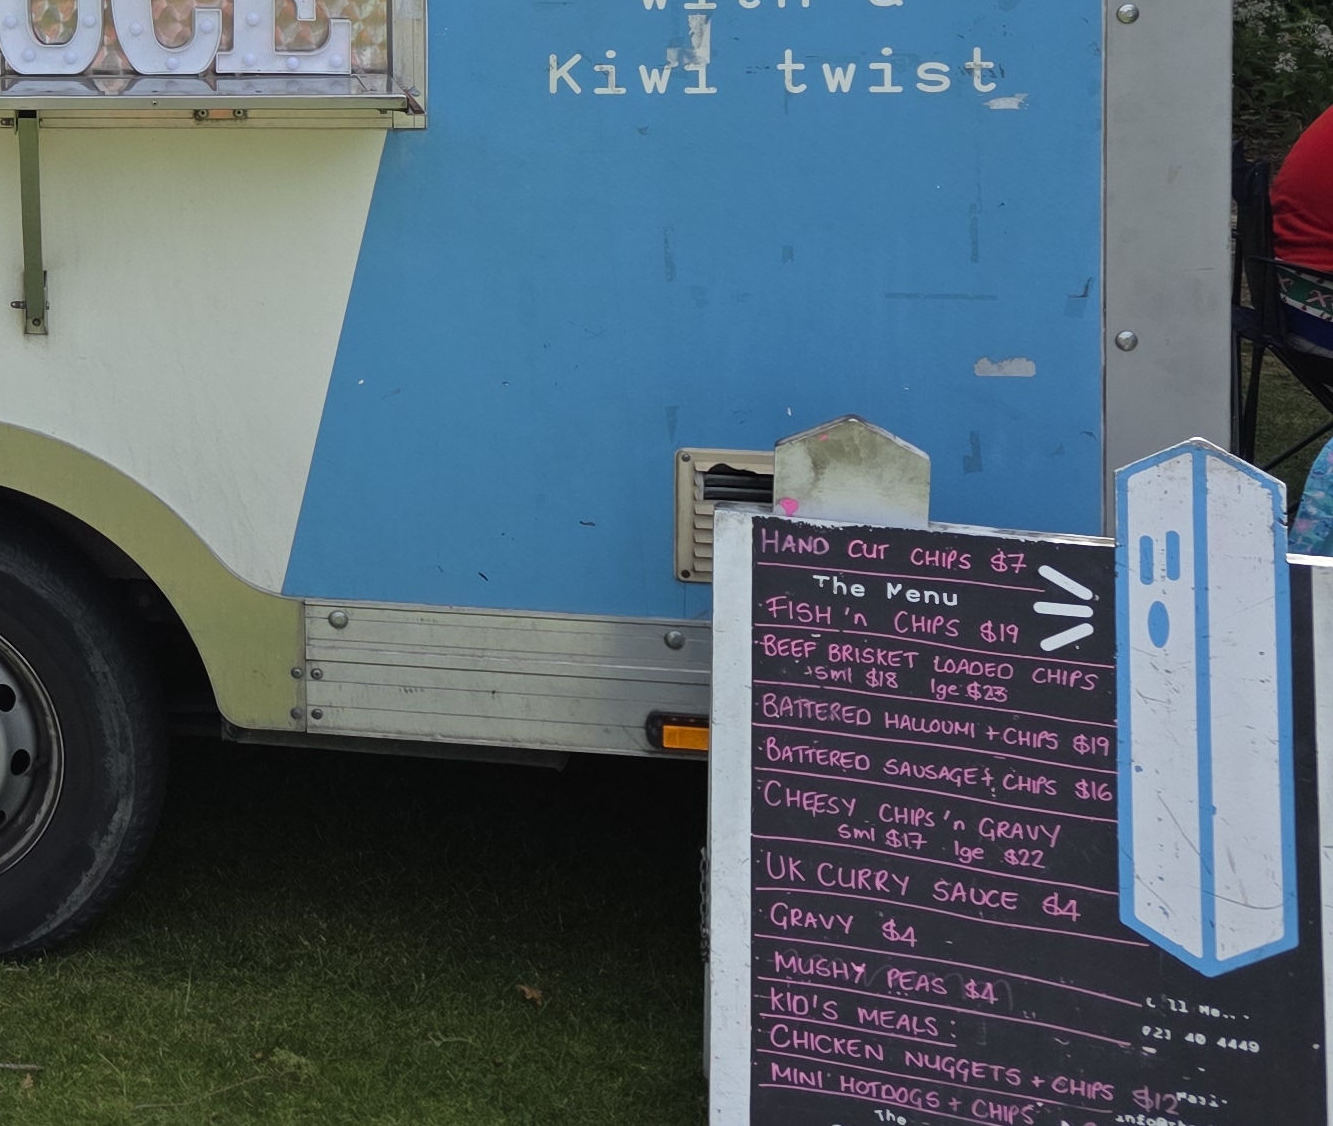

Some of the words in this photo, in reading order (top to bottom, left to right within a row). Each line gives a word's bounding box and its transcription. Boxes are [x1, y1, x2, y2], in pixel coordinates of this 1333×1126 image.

[777, 47, 997, 93] twist
[761, 528, 830, 555] HAND
[847, 539, 890, 560] CUT
[911, 548, 971, 570] CHIPS
[990, 550, 1027, 574] $7
[812, 574, 865, 597] The
[887, 582, 958, 606] Menu
[766, 596, 832, 625] FISH
[894, 611, 960, 638] CHIPS
[980, 620, 1019, 644] $19
[763, 633, 818, 658] BEEF
[829, 643, 919, 668] BRISKET
[933, 655, 1014, 680] LOADED
[1032, 667, 1099, 691] CHIPS
[865, 668, 899, 689] $18
[762, 693, 871, 725] BATTERED
[884, 712, 975, 738] HALLOUMI
[1002, 727, 1058, 750] CHIPS
[1073, 735, 1110, 757] $19
[766, 737, 870, 771] BATTERED
[883, 759, 980, 787] SAUSAGE
[1002, 773, 1057, 796] CHIPS
[1075, 780, 1114, 802] $16
[764, 780, 857, 817] CHEESY
[879, 803, 936, 827] CHIPS
[978, 818, 1061, 848] GRAVY
[885, 829, 927, 849] $17
[1004, 848, 1046, 869] $22
[766, 851, 806, 882] UK
[817, 863, 910, 896] CURRY
[932, 881, 1019, 909] SAUCE
[1042, 892, 1081, 922] $4
[770, 902, 853, 934] GRAVY
[882, 918, 918, 947] $4
[774, 951, 866, 983] MUSHY
[887, 968, 948, 995] PEAS
[965, 979, 999, 1004] $4
[770, 990, 838, 1020] KID'S
[770, 1024, 884, 1061] CHICKEN
[905, 1050, 1022, 1085] NUGGETS
[1051, 1076, 1115, 1101] CHIPS
[1133, 1084, 1176, 1116] $12
[771, 1062, 824, 1087] MINI
[840, 1076, 940, 1109] HOTDOGS
[971, 1098, 1035, 1125] CHIPS
